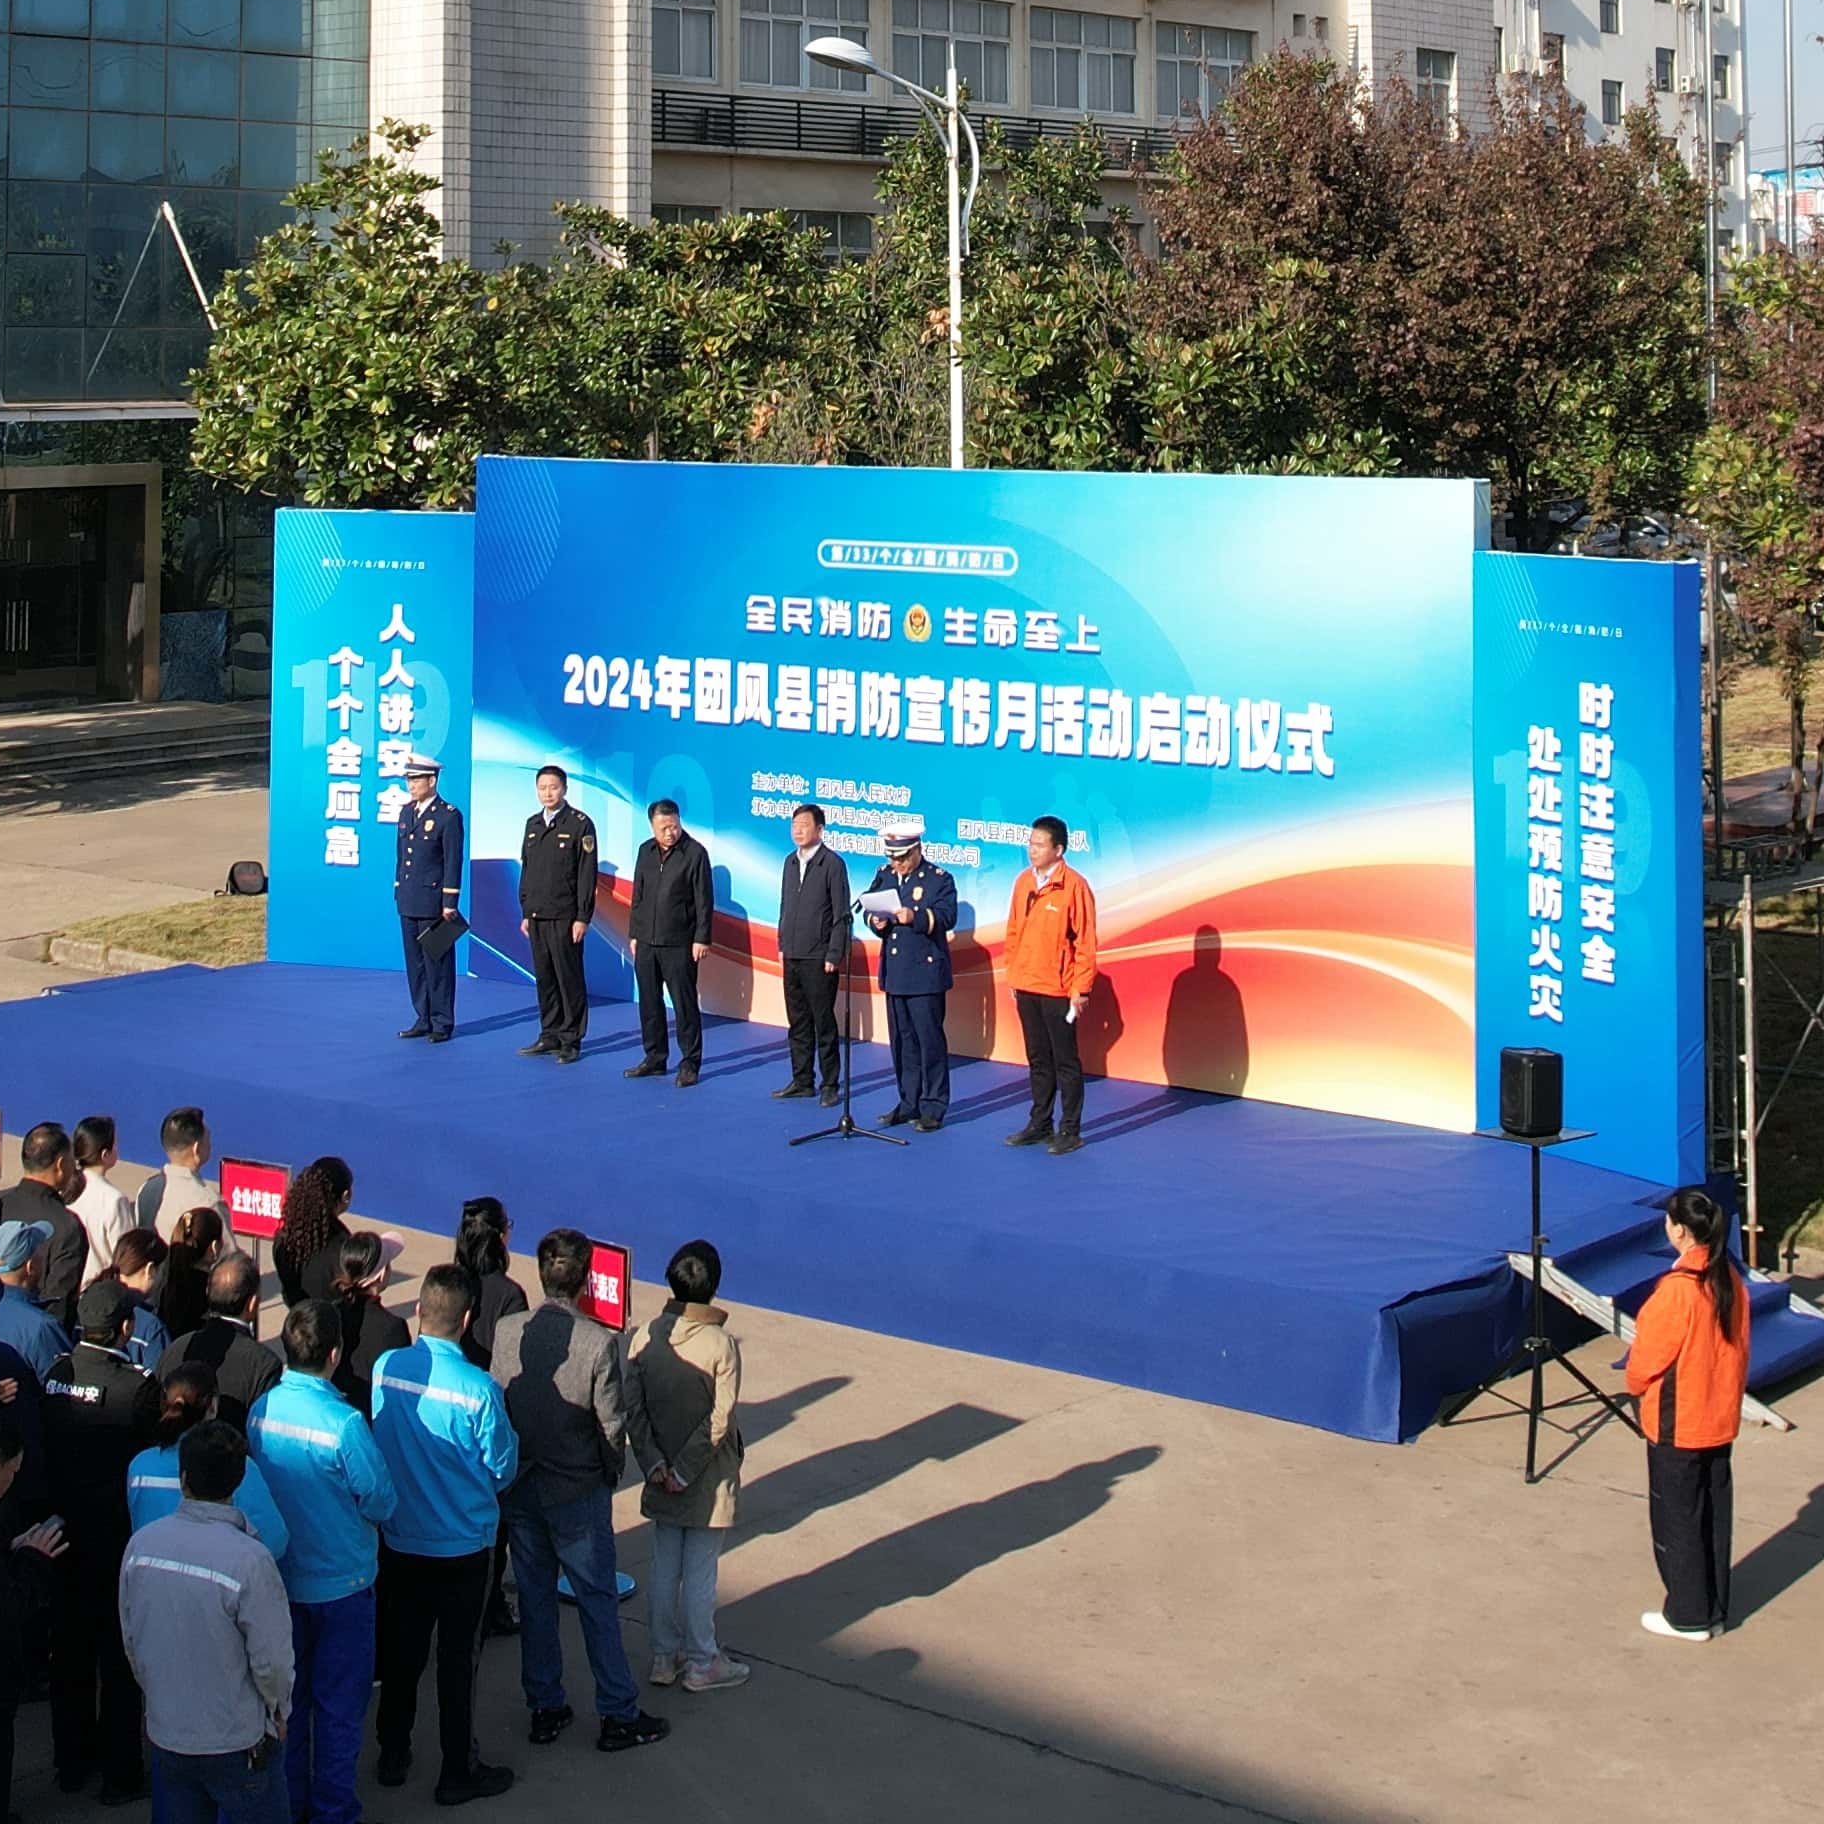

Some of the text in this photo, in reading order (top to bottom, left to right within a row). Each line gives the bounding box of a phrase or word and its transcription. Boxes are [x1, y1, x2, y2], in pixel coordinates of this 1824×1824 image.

[378, 603, 417, 824] 人人讲安全
[562, 653, 1336, 778] 2024年团风县消防宣传月活动启动仪式
[746, 594, 1102, 654] 全民消防 生命至上
[324, 646, 364, 867] 个个会应急
[1577, 681, 1617, 985] 时时注意安全
[1527, 724, 1564, 1024] 处处预防火灾
[231, 1185, 282, 1219] 企业代表区
